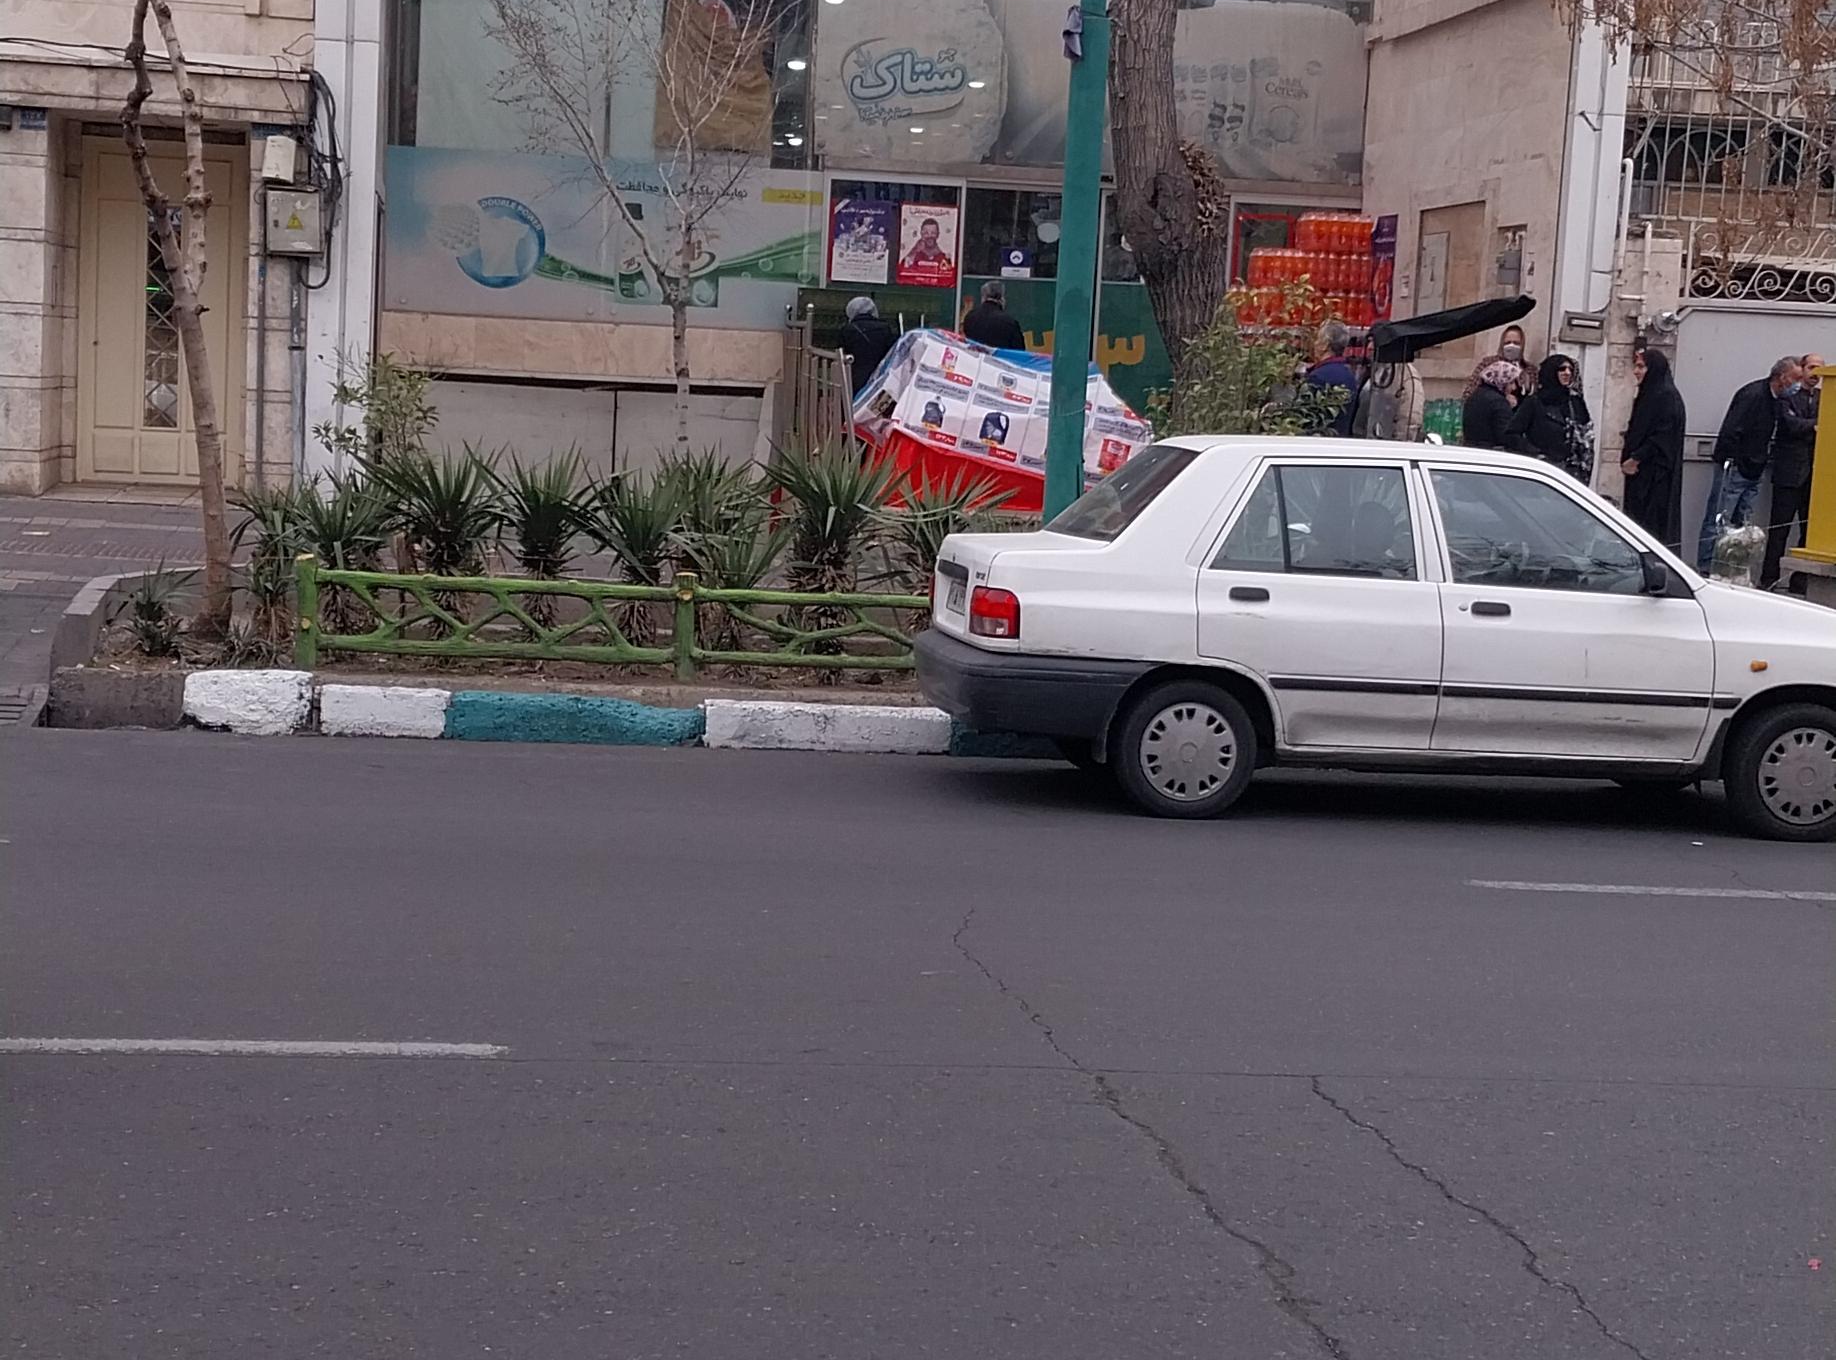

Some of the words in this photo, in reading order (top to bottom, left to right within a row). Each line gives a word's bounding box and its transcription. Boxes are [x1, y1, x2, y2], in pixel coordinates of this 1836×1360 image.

[850, 51, 965, 101] ستاک
[481, 198, 517, 210] DOUBLE
[517, 204, 543, 232] POWER
